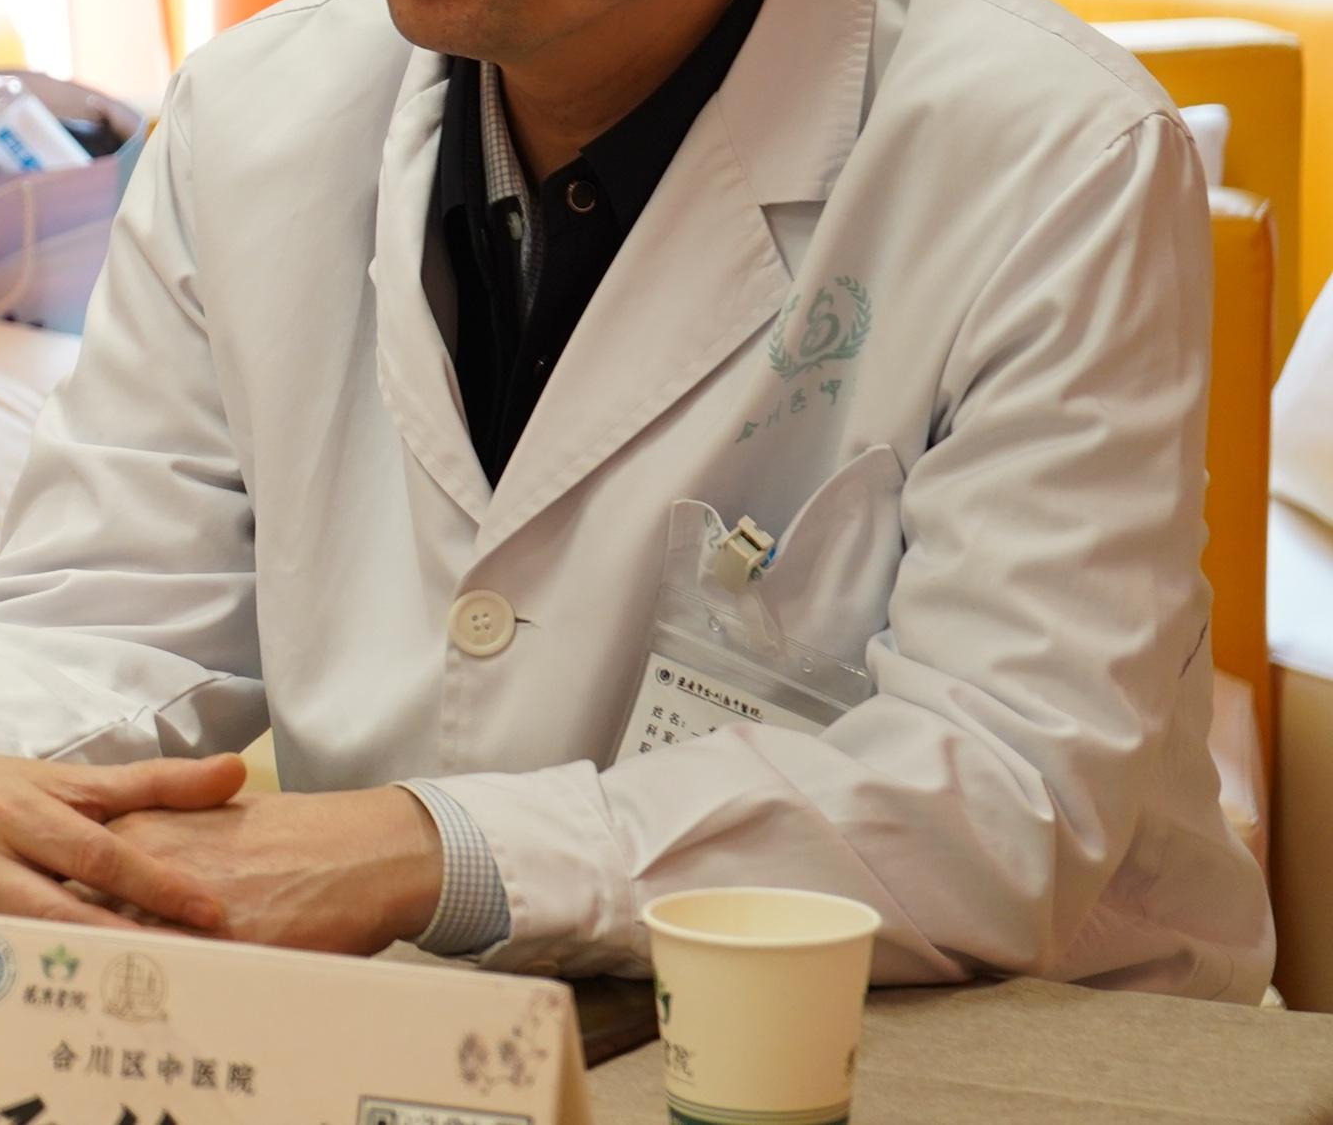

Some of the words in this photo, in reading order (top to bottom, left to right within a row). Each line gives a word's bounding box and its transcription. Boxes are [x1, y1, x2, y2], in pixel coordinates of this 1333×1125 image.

[51, 1040, 256, 1096] 合川区中医院
